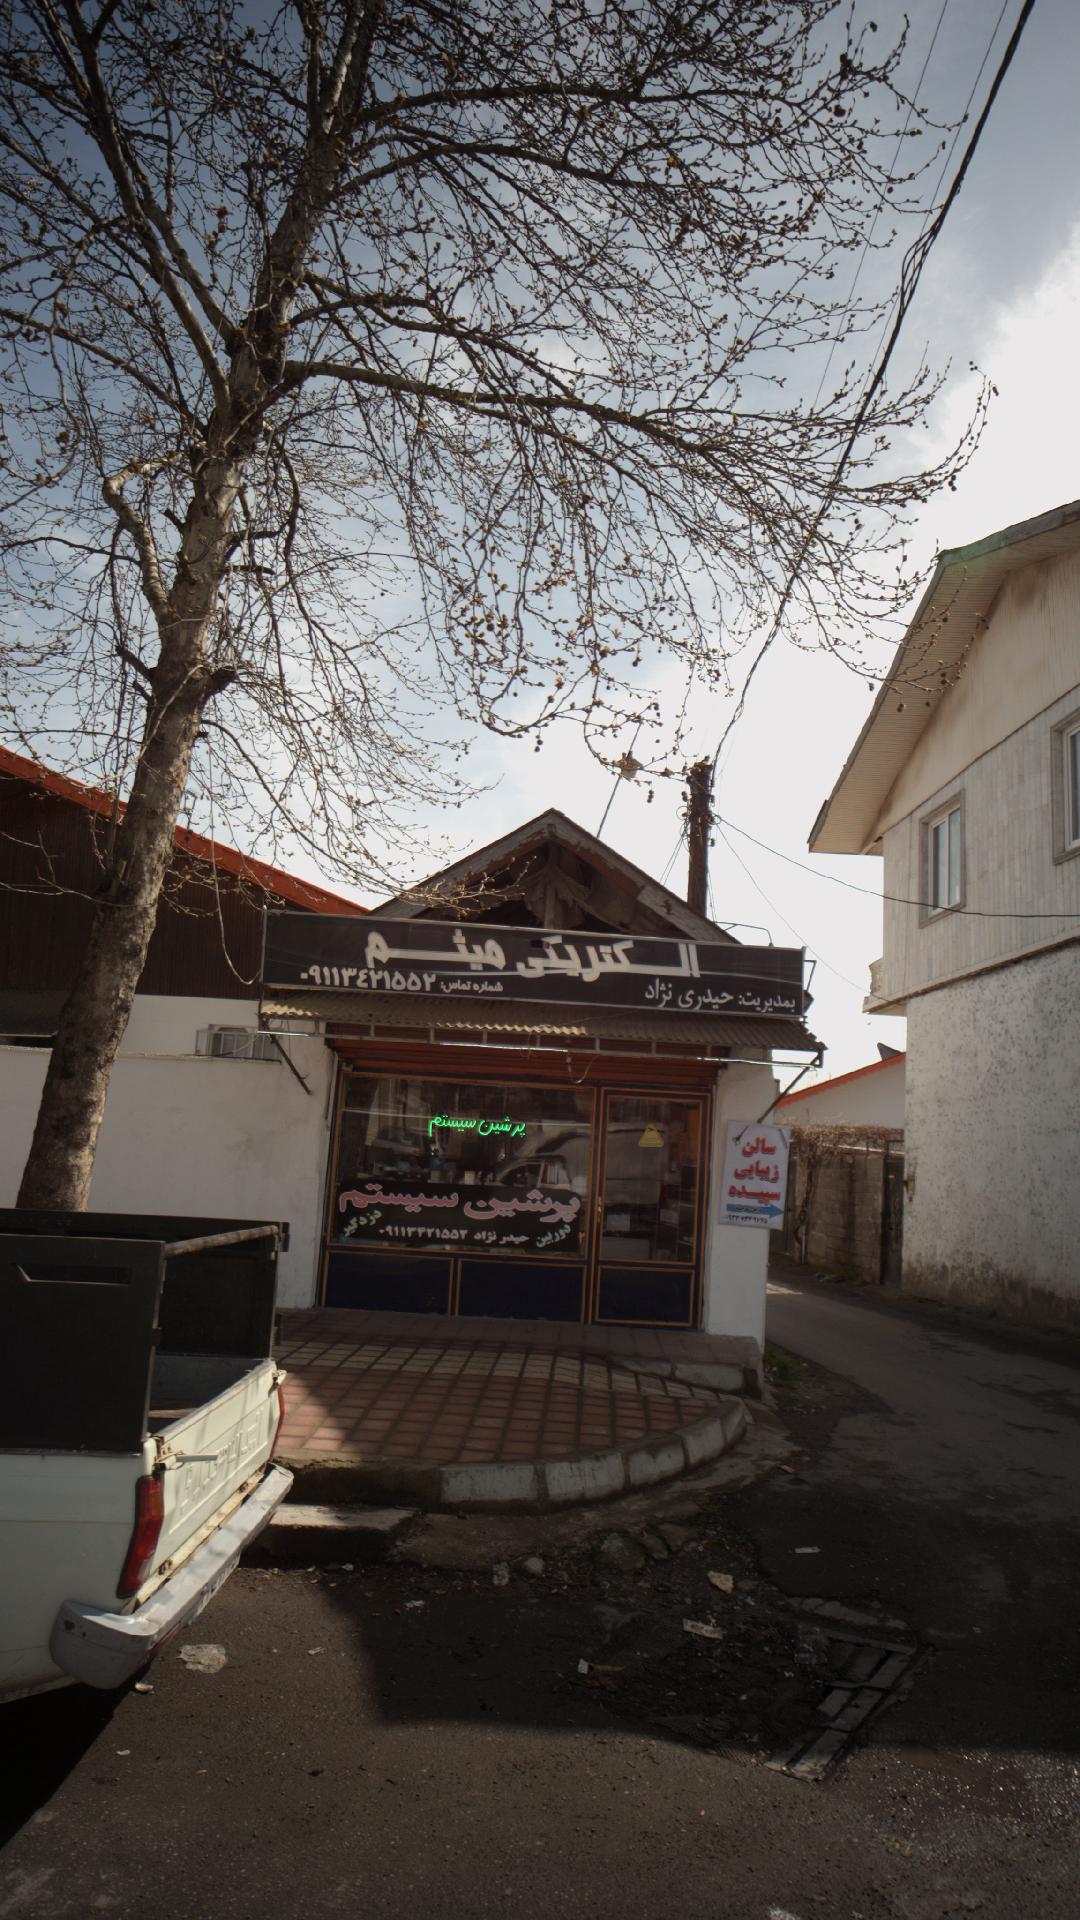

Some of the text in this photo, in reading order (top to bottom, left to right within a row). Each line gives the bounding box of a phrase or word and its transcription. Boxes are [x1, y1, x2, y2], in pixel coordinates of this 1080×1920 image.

[365, 928, 506, 970] هیثم
[473, 981, 503, 993] شماره
[645, 978, 672, 1008] نژاد
[678, 991, 733, 1010] حیدری
[428, 1114, 526, 1137] پرشین سیستم
[742, 1137, 776, 1157] سالن
[734, 1160, 780, 1183] زیبایی
[339, 1183, 581, 1223] پرشین سیستم
[728, 1185, 781, 1205] سپیده
[343, 1209, 382, 1237] دزدگیر
[473, 1230, 497, 1244] نژاد
[536, 1223, 571, 1248] دوربین
